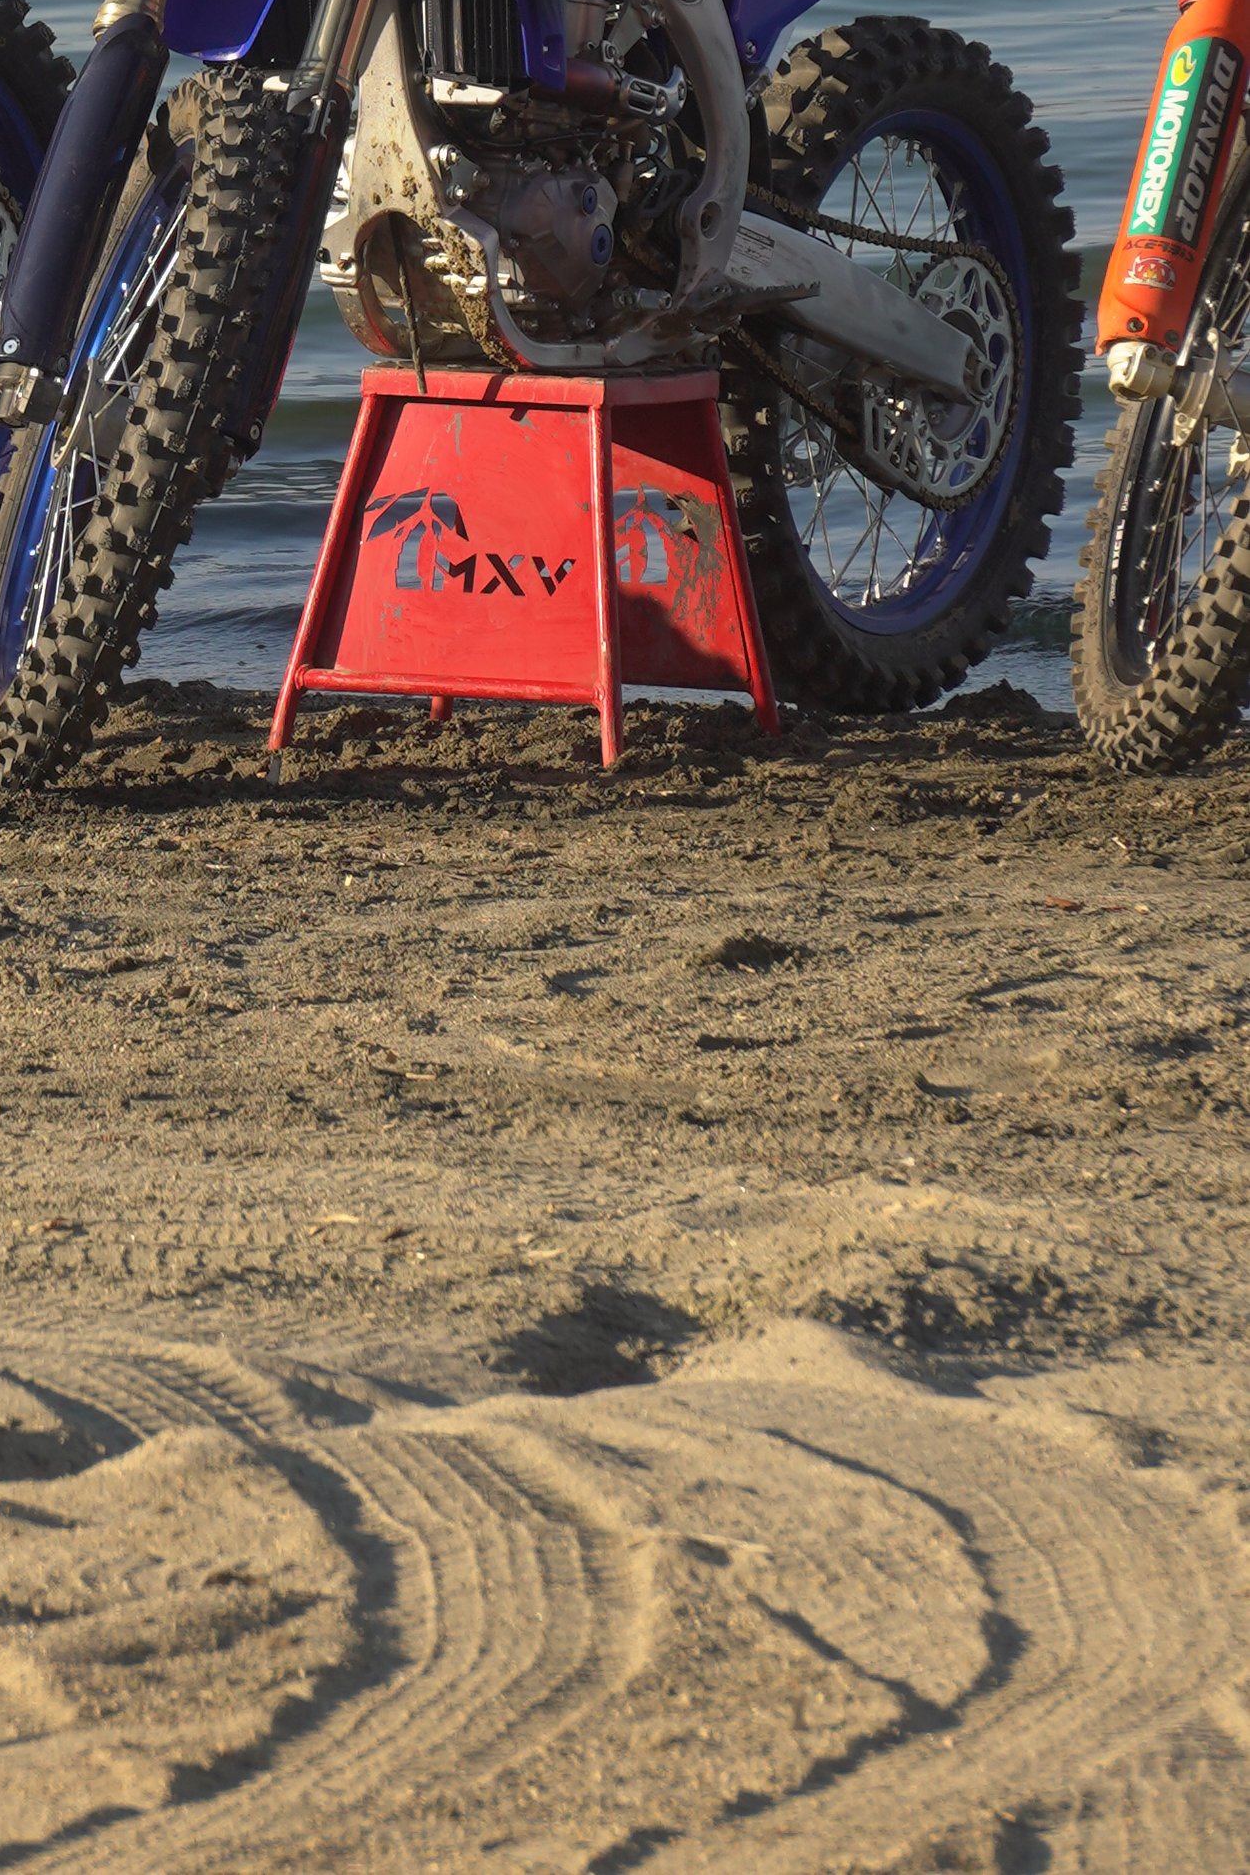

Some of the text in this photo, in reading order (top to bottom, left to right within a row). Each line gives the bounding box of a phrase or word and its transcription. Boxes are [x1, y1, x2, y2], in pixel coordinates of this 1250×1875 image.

[1132, 88, 1190, 231] MOTOREX
[1174, 45, 1238, 243] DUNLOP
[432, 549, 577, 597] MXV
